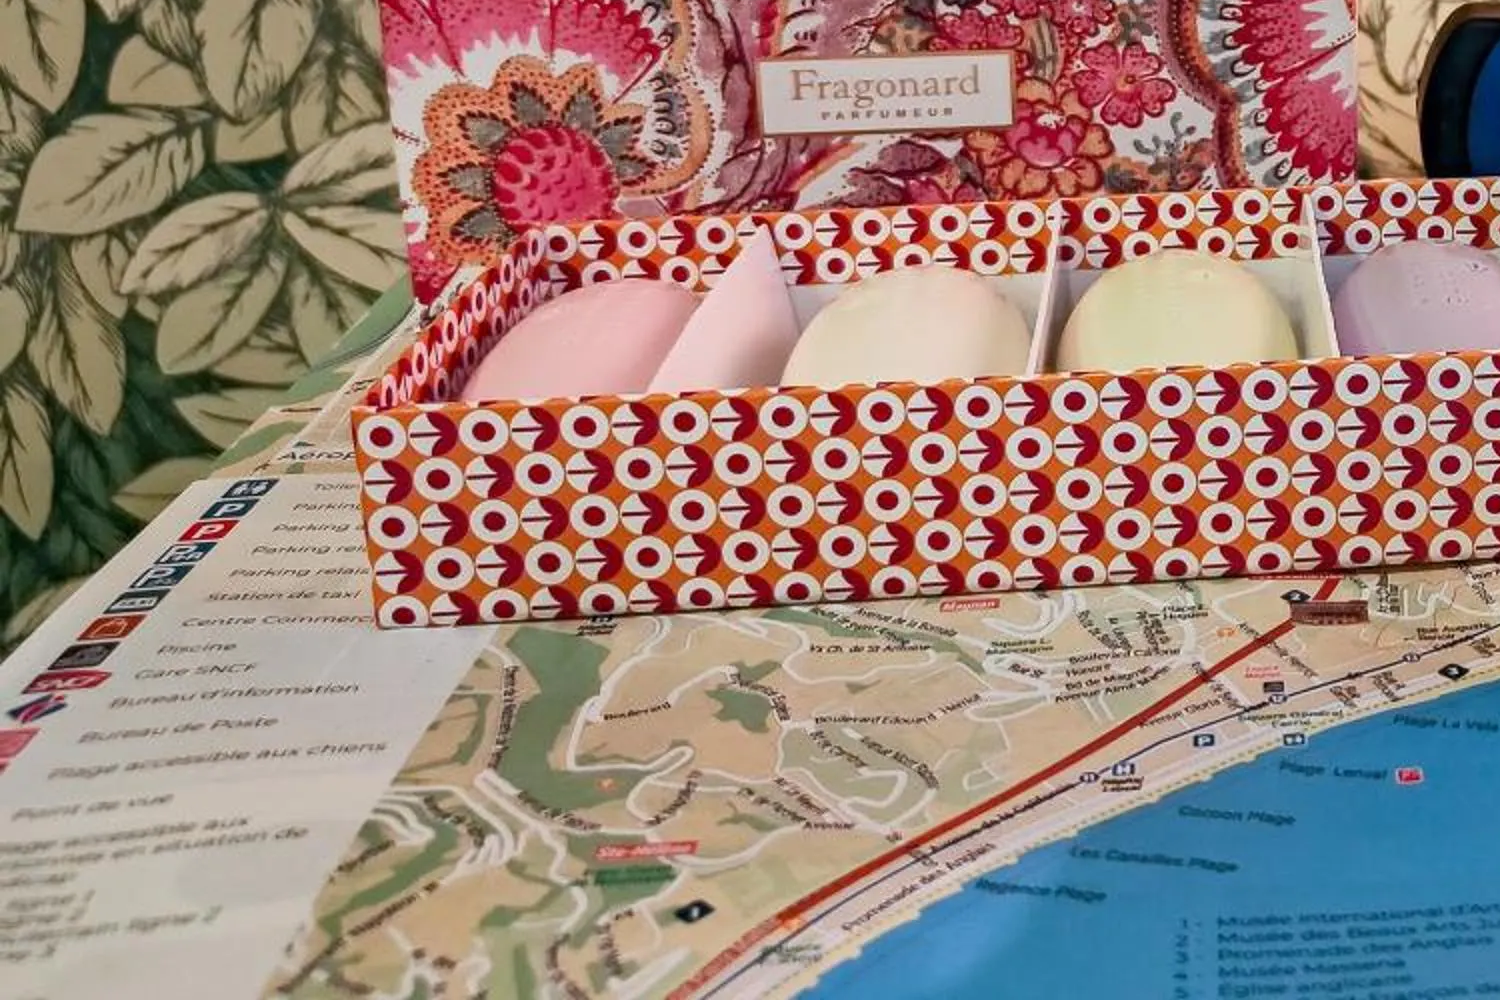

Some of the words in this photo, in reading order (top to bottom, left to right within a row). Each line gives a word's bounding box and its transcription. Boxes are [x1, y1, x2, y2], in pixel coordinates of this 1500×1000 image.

[791, 64, 981, 108] Fragonard
[821, 107, 953, 121] PARFUMEUR
[272, 523, 350, 533] Parking
[252, 545, 335, 556] Parking
[229, 567, 312, 578] Parking
[206, 592, 285, 602] Station
[288, 590, 313, 599] de
[320, 589, 363, 600] taxi
[182, 615, 260, 628] Centre
[157, 643, 238, 657] Piscine
[133, 668, 193, 682] Gare
[198, 662, 259, 677] SNCF
[109, 692, 197, 710] Bureau
[200, 683, 361, 701] d'information
[78, 726, 169, 744] Bureau
[173, 721, 204, 733] de
[210, 716, 279, 732] Poste
[1393, 714, 1438, 729] Plage
[1442, 717, 1461, 730] La
[256, 746, 302, 761] aux
[306, 740, 388, 757] chiens
[1279, 759, 1326, 777] Plage
[1334, 764, 1388, 781] Lenval
[1178, 803, 1244, 823] Cocoon
[1246, 809, 1296, 828] Plage
[1069, 844, 1103, 860] Les
[1188, 857, 1241, 874] Plage
[1053, 884, 1108, 904] Plage
[1299, 928, 1342, 942] des
